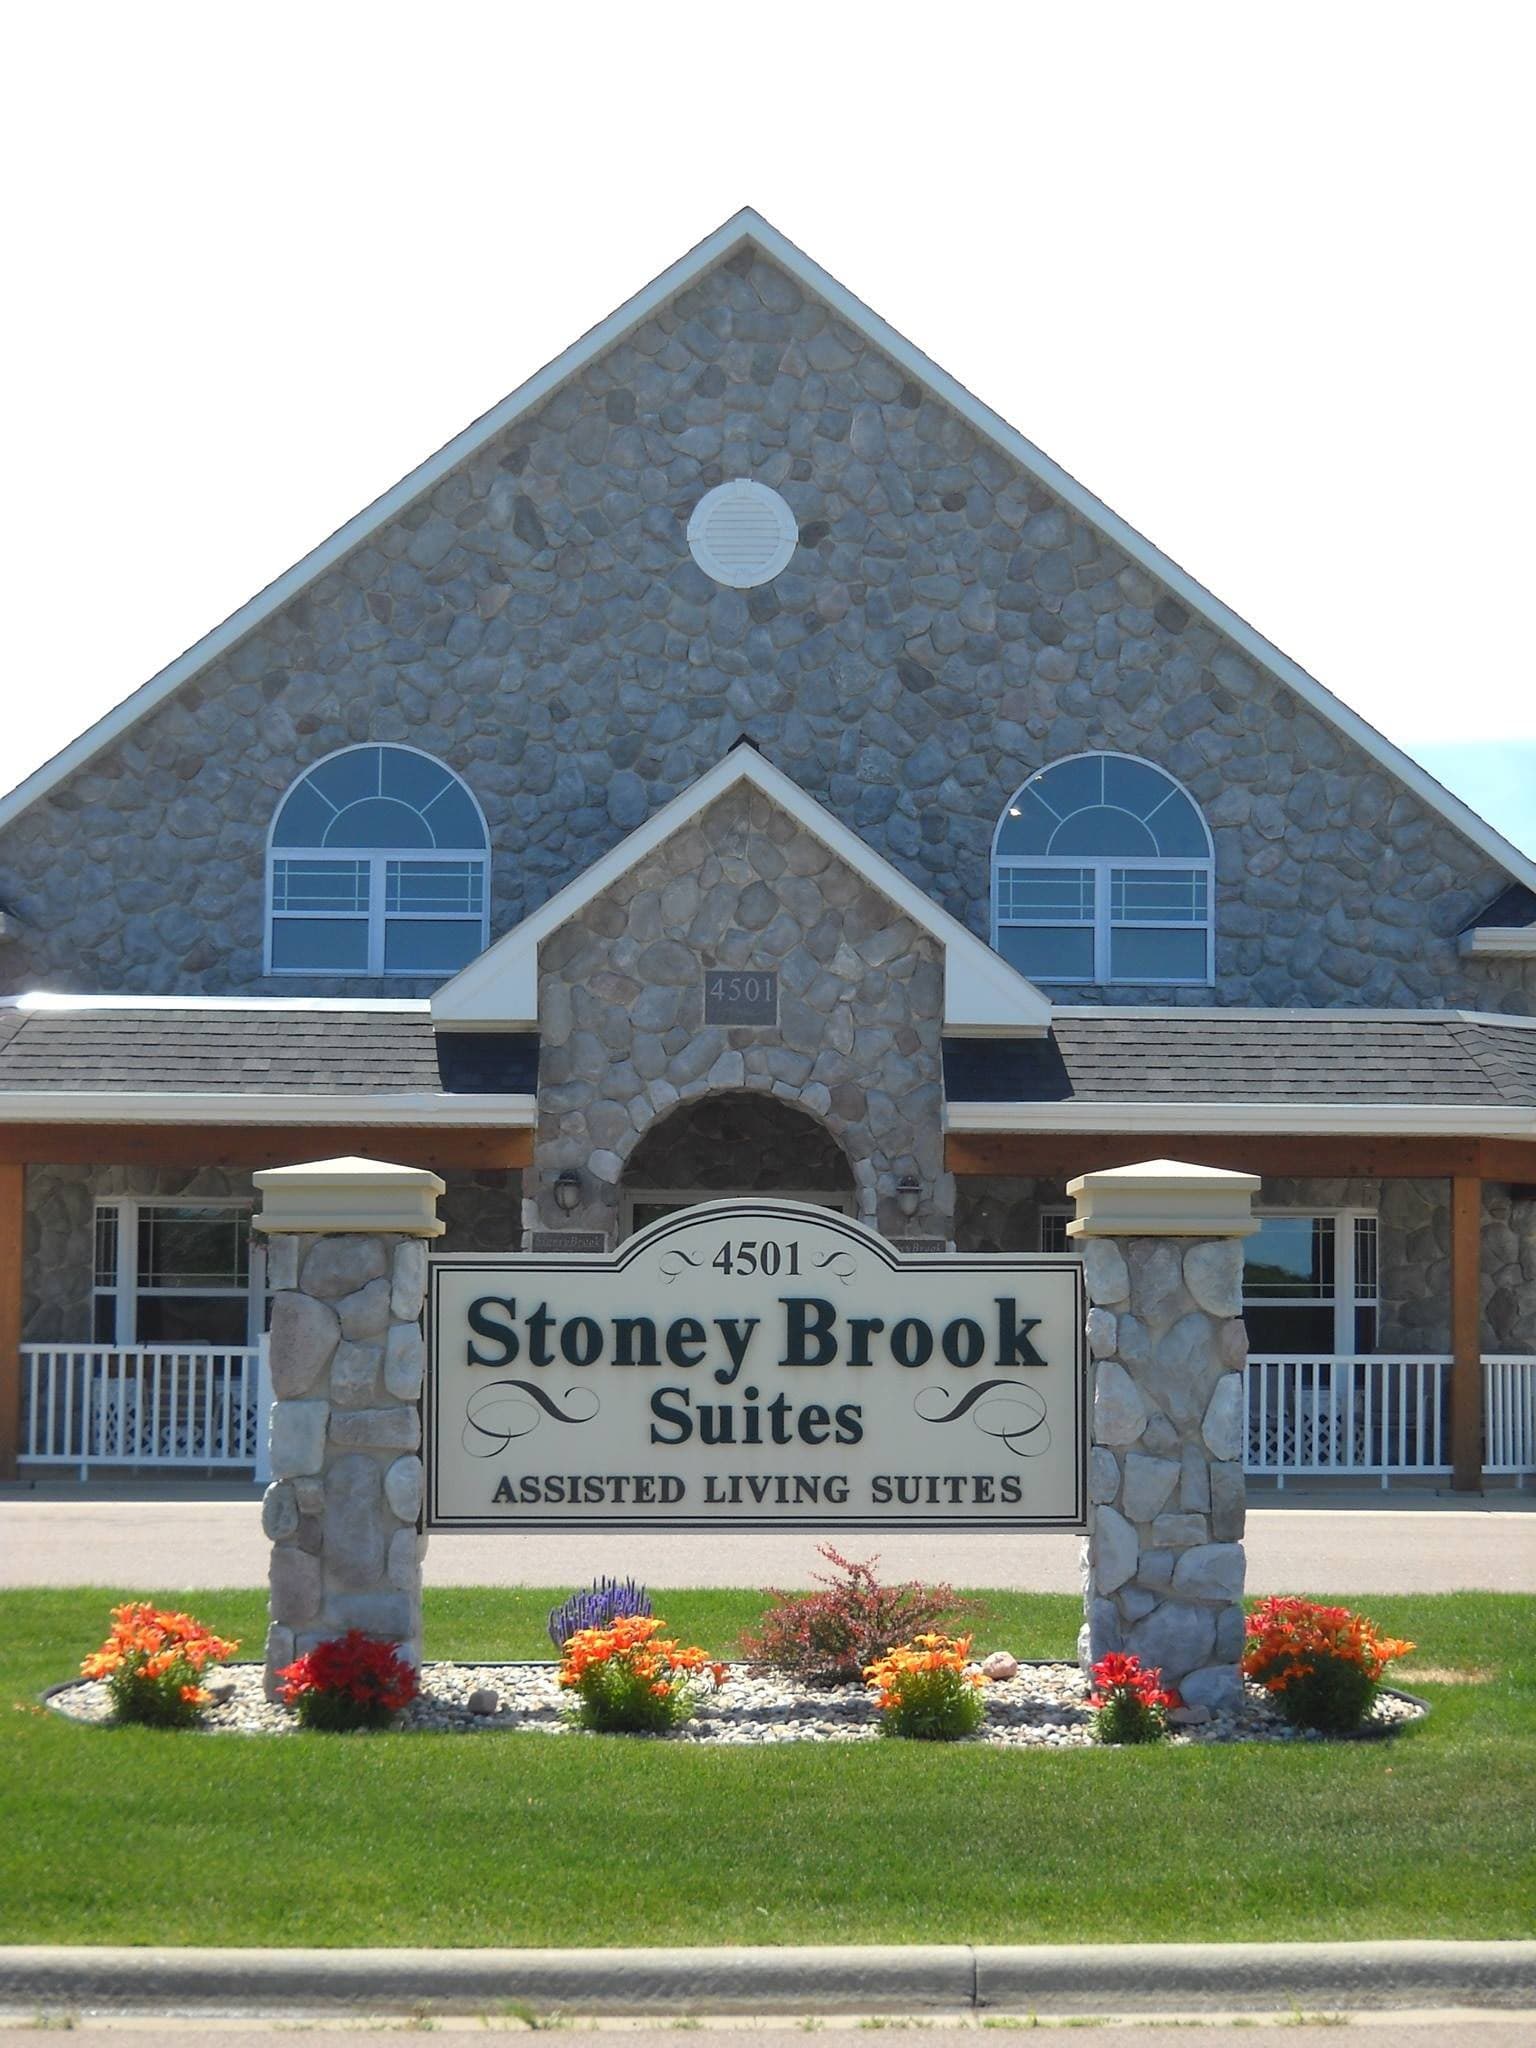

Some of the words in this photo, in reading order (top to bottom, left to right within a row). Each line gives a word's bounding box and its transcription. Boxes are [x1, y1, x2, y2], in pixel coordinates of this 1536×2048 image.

[710, 977, 771, 1002] 4501
[713, 1241, 802, 1276] 4501
[467, 1296, 761, 1384] Stoney
[778, 1298, 1048, 1368] Brook
[651, 1386, 863, 1445] Suites
[491, 1475, 686, 1504] ASSISTED
[704, 1475, 850, 1504] LIVING
[872, 1475, 1023, 1504] SUITES
